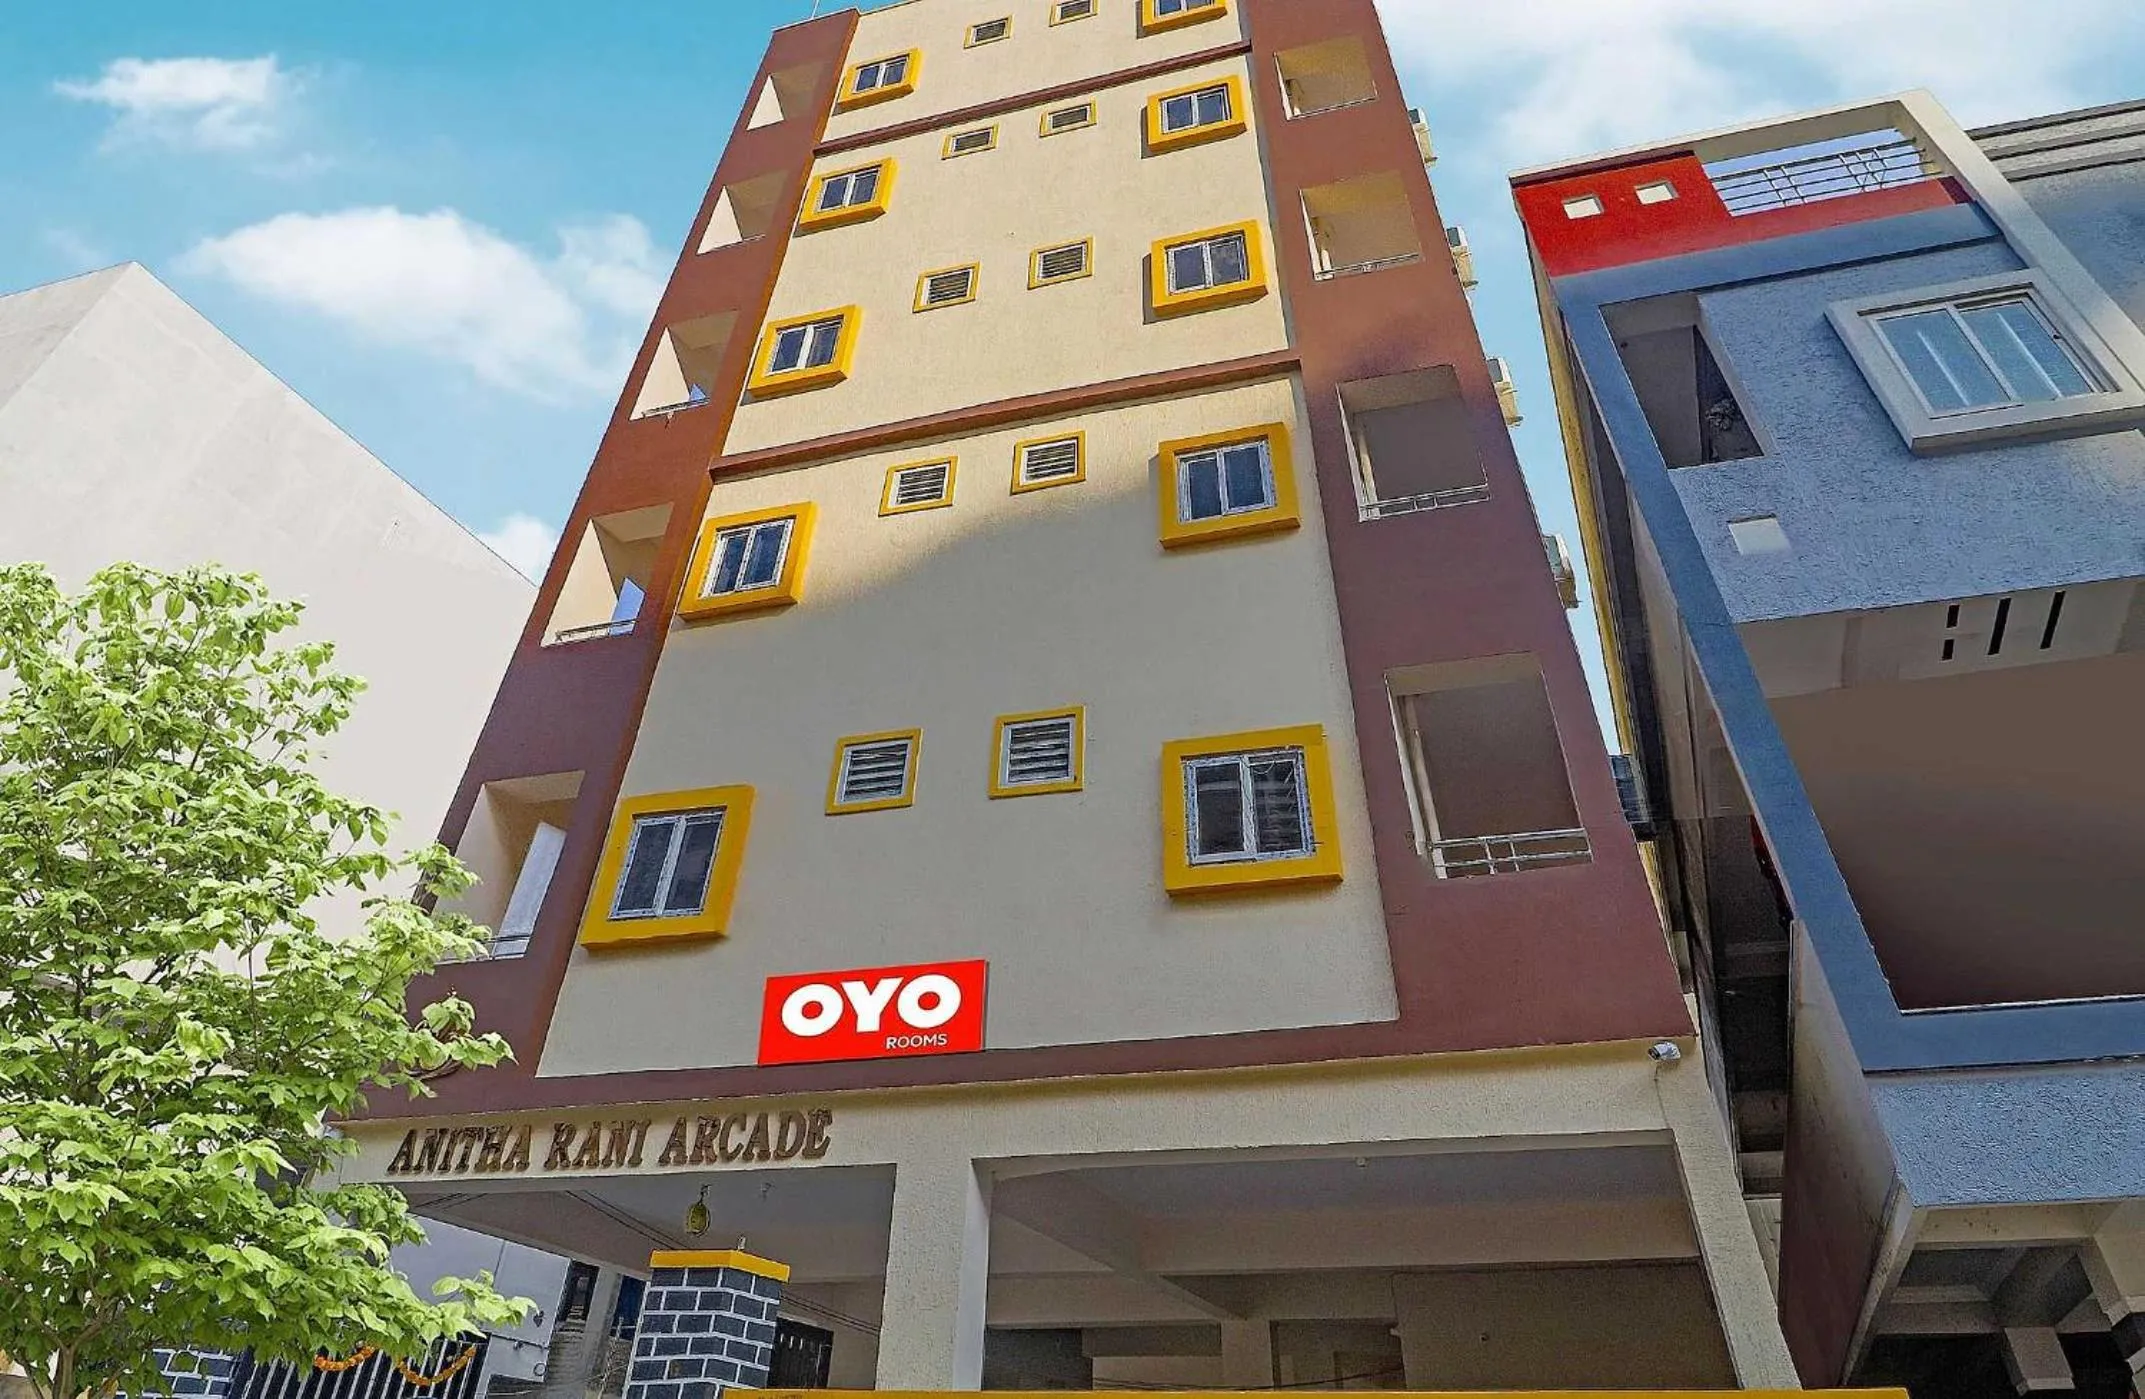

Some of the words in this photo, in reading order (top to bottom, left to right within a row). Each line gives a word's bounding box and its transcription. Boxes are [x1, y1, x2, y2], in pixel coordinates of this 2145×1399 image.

[781, 974, 962, 1037] OYO
[886, 1034, 948, 1049] ROOMS
[386, 1126, 532, 1175] ANITHA
[543, 1118, 652, 1169] RANI
[658, 1108, 833, 1166] ARCADE
